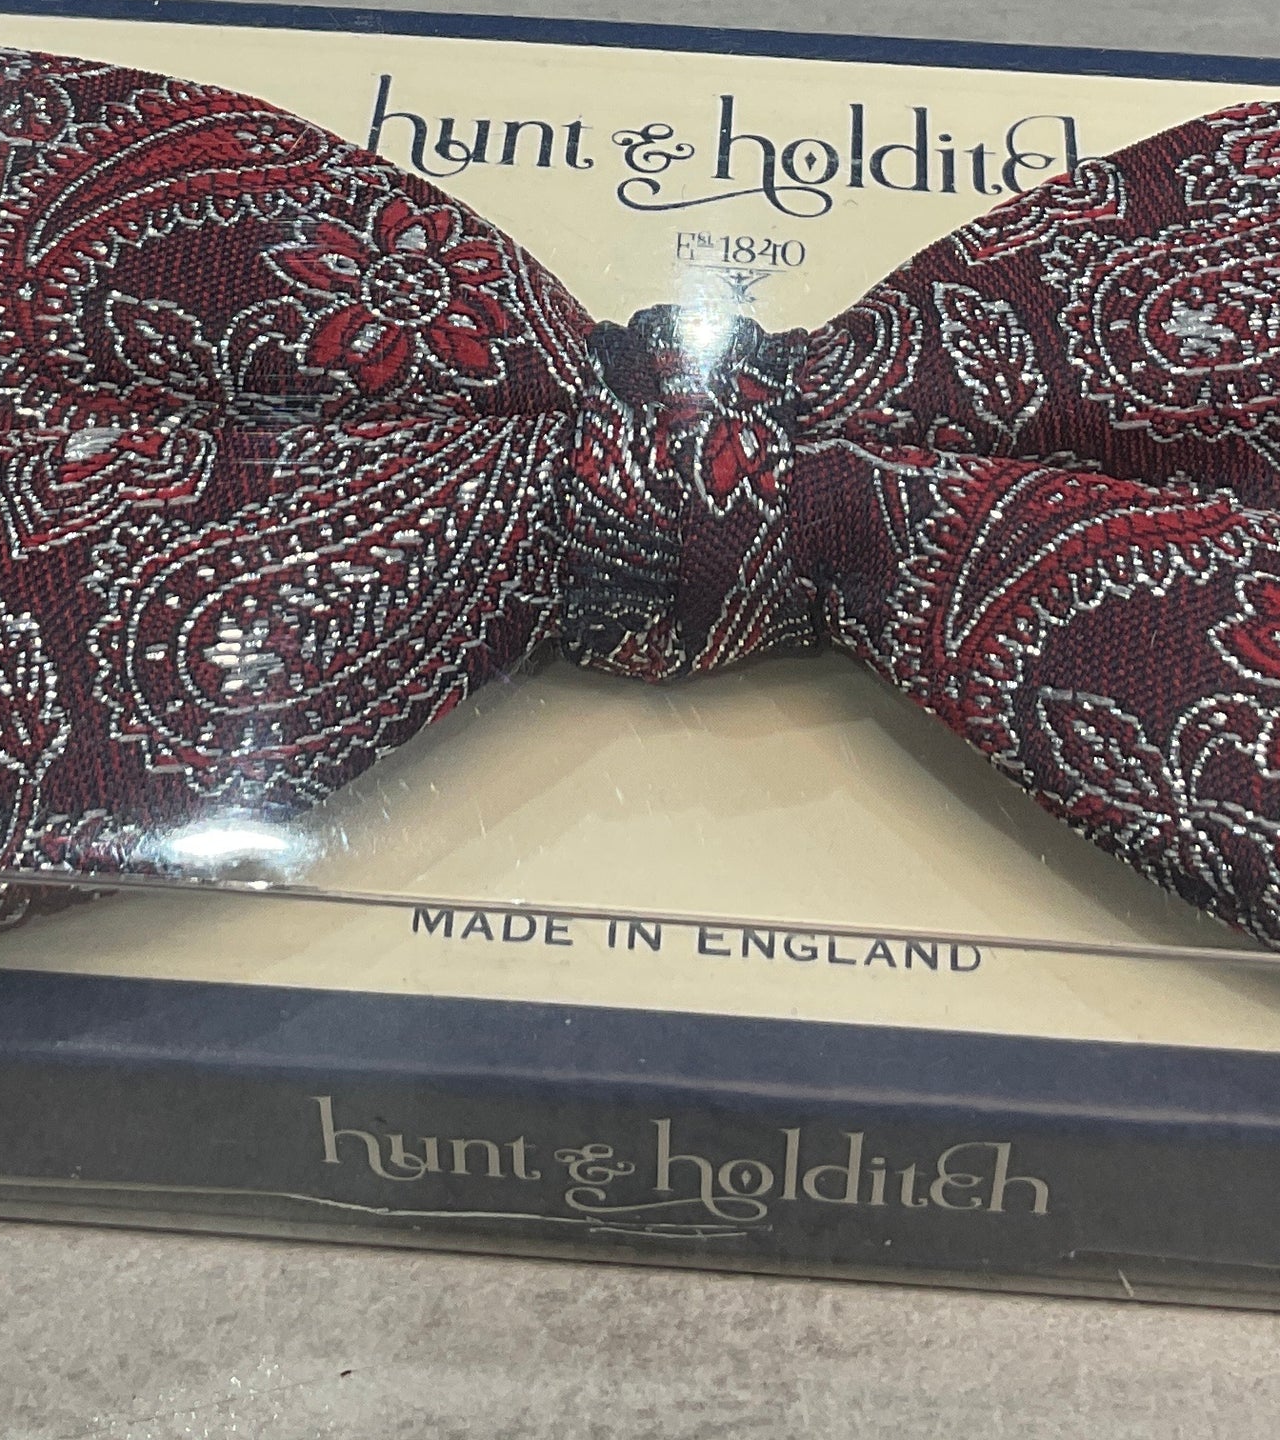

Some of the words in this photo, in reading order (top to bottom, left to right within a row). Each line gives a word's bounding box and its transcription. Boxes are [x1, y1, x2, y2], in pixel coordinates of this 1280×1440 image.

[370, 74, 594, 177] hunt
[611, 122, 695, 174] &
[720, 235, 806, 267] 1840
[412, 906, 574, 946] MADE
[607, 918, 662, 952] IN
[697, 925, 982, 972] ENGLAND
[310, 1096, 542, 1182] hunt
[554, 1143, 636, 1193] &
[566, 1118, 1051, 1221] holditch
